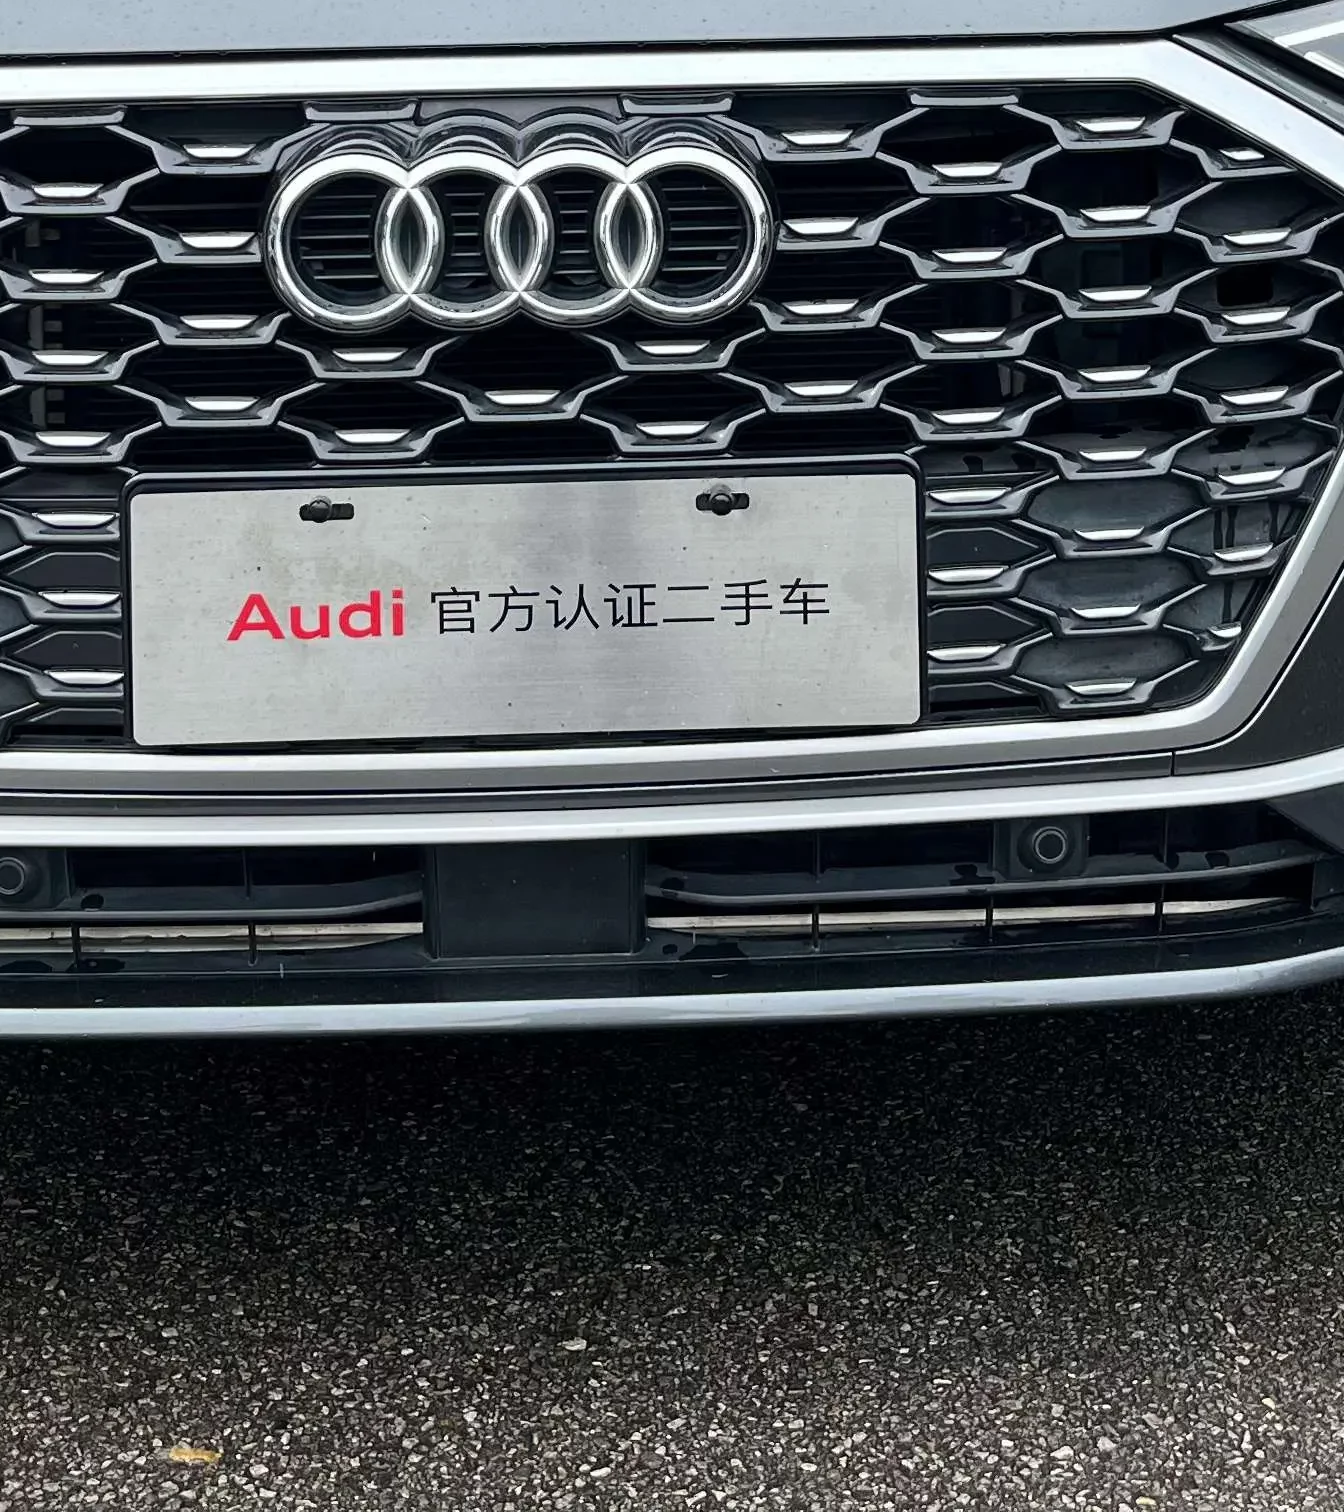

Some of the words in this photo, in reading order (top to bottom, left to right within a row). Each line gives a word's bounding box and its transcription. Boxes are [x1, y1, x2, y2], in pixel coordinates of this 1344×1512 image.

[226, 588, 406, 642] Audi
[429, 577, 832, 636] 官方认证二手车
